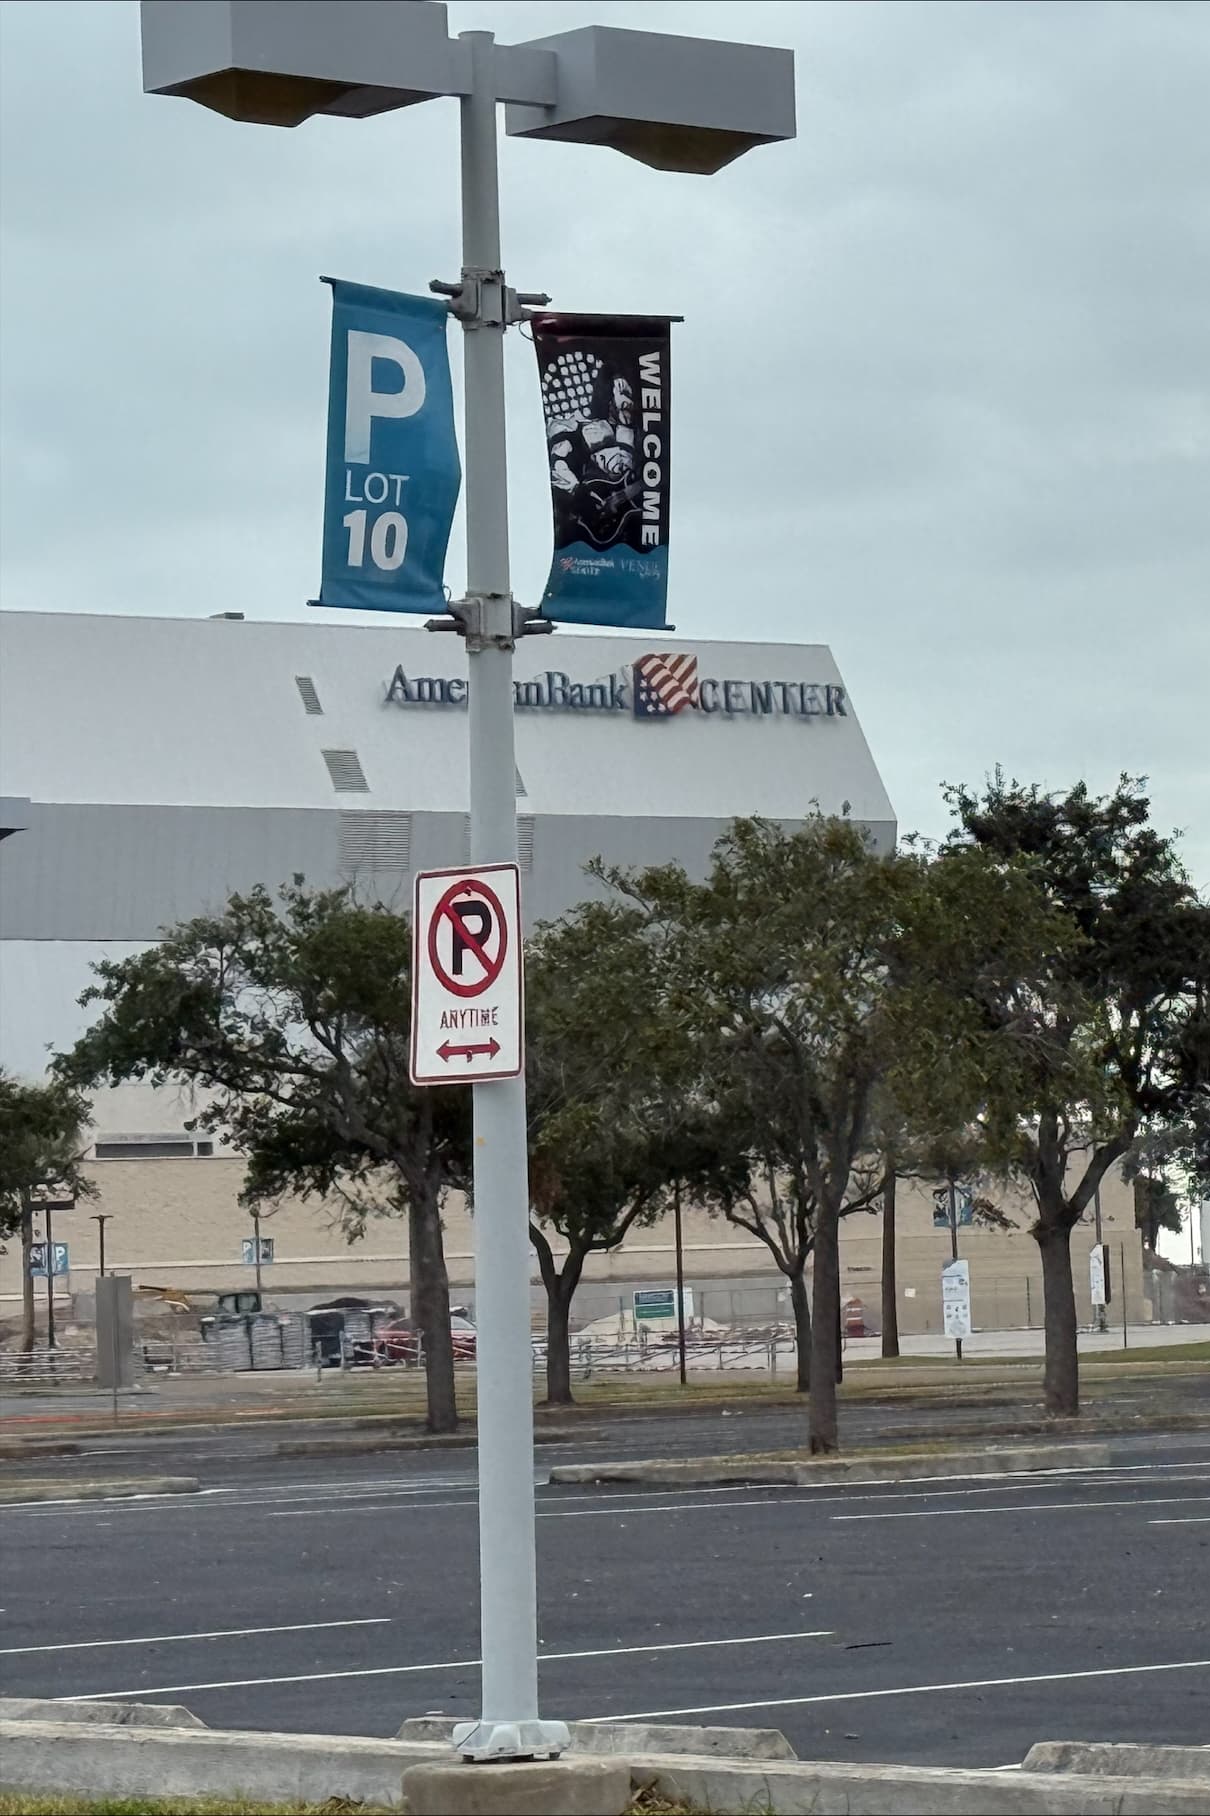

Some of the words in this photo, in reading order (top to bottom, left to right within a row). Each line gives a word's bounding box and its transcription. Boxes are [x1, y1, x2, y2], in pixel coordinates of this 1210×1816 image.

[345, 330, 426, 464] P
[638, 352, 661, 546] WELCOME
[345, 469, 410, 506] LOT
[343, 509, 408, 571] 10
[384, 664, 628, 709] AmenBank
[700, 678, 847, 716] CENTER
[440, 1006, 499, 1030] ANYTIME
